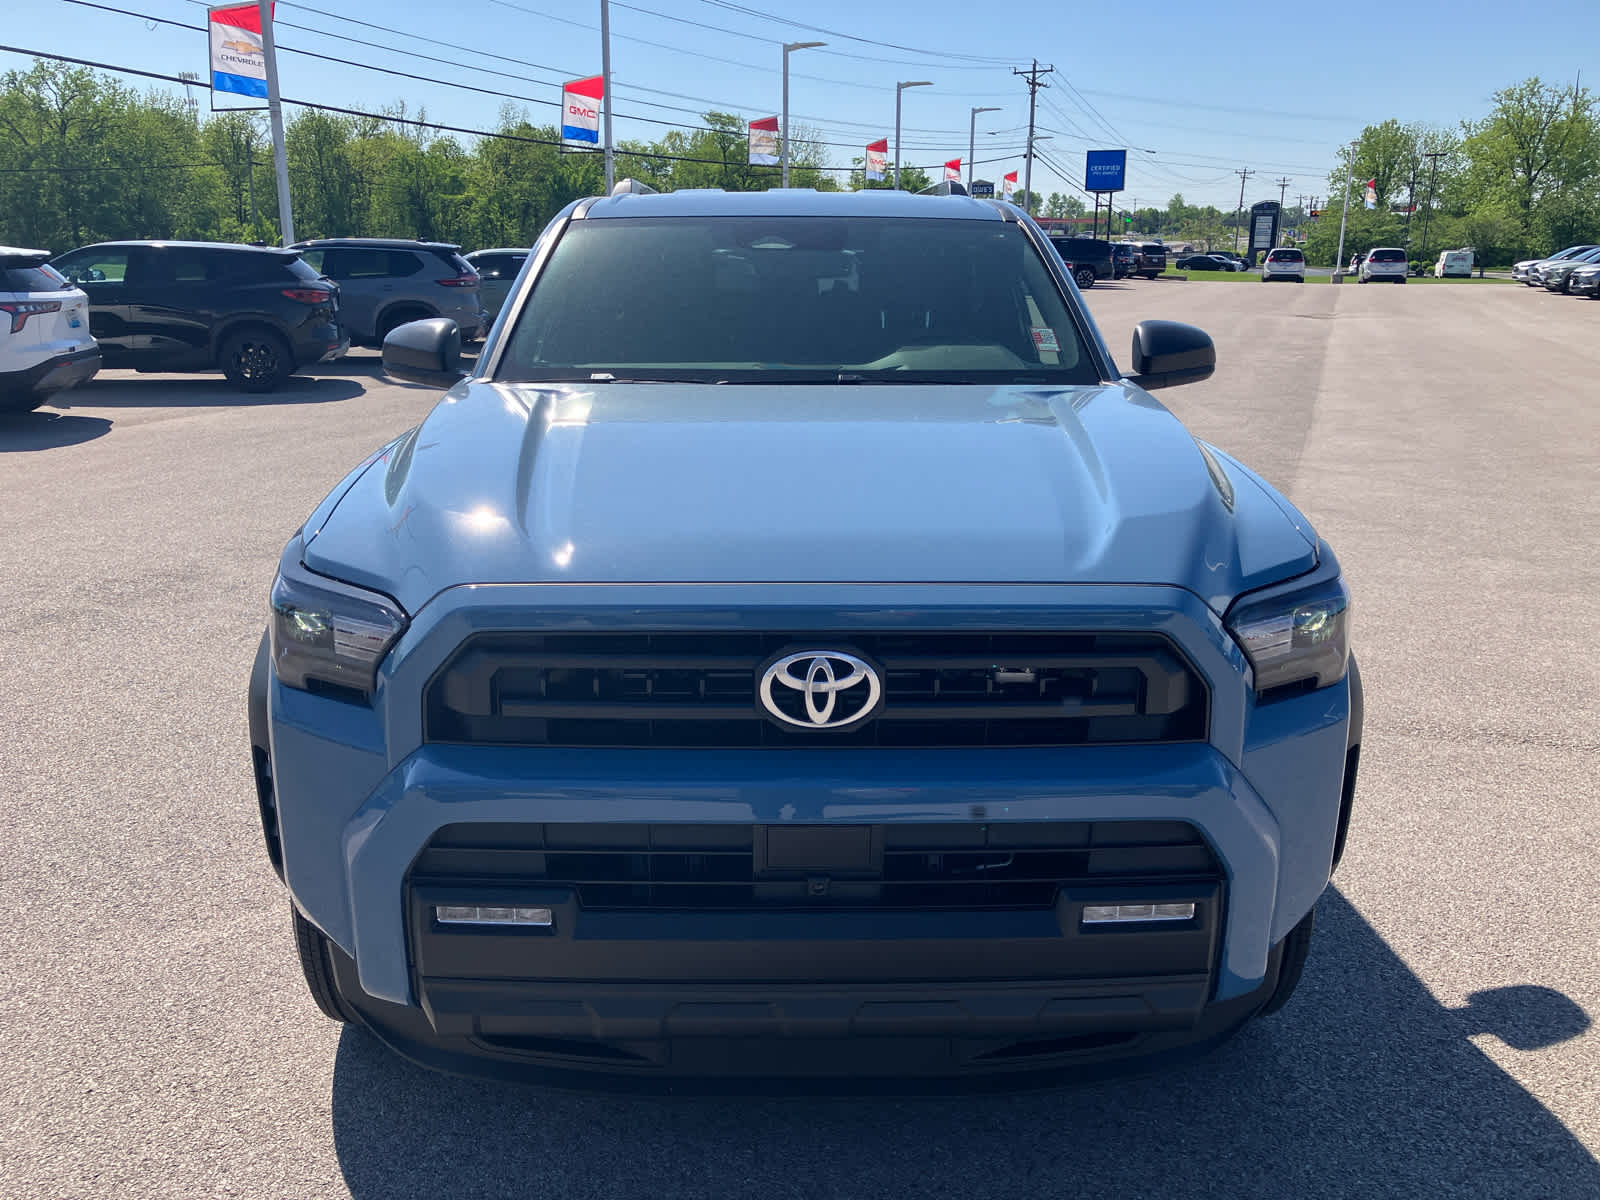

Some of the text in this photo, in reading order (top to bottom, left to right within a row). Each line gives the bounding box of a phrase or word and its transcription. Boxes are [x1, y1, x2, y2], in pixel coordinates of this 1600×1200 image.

[220, 54, 264, 68] CHEVROLE
[569, 105, 596, 119] GMC
[973, 185, 993, 193] OWE'S
